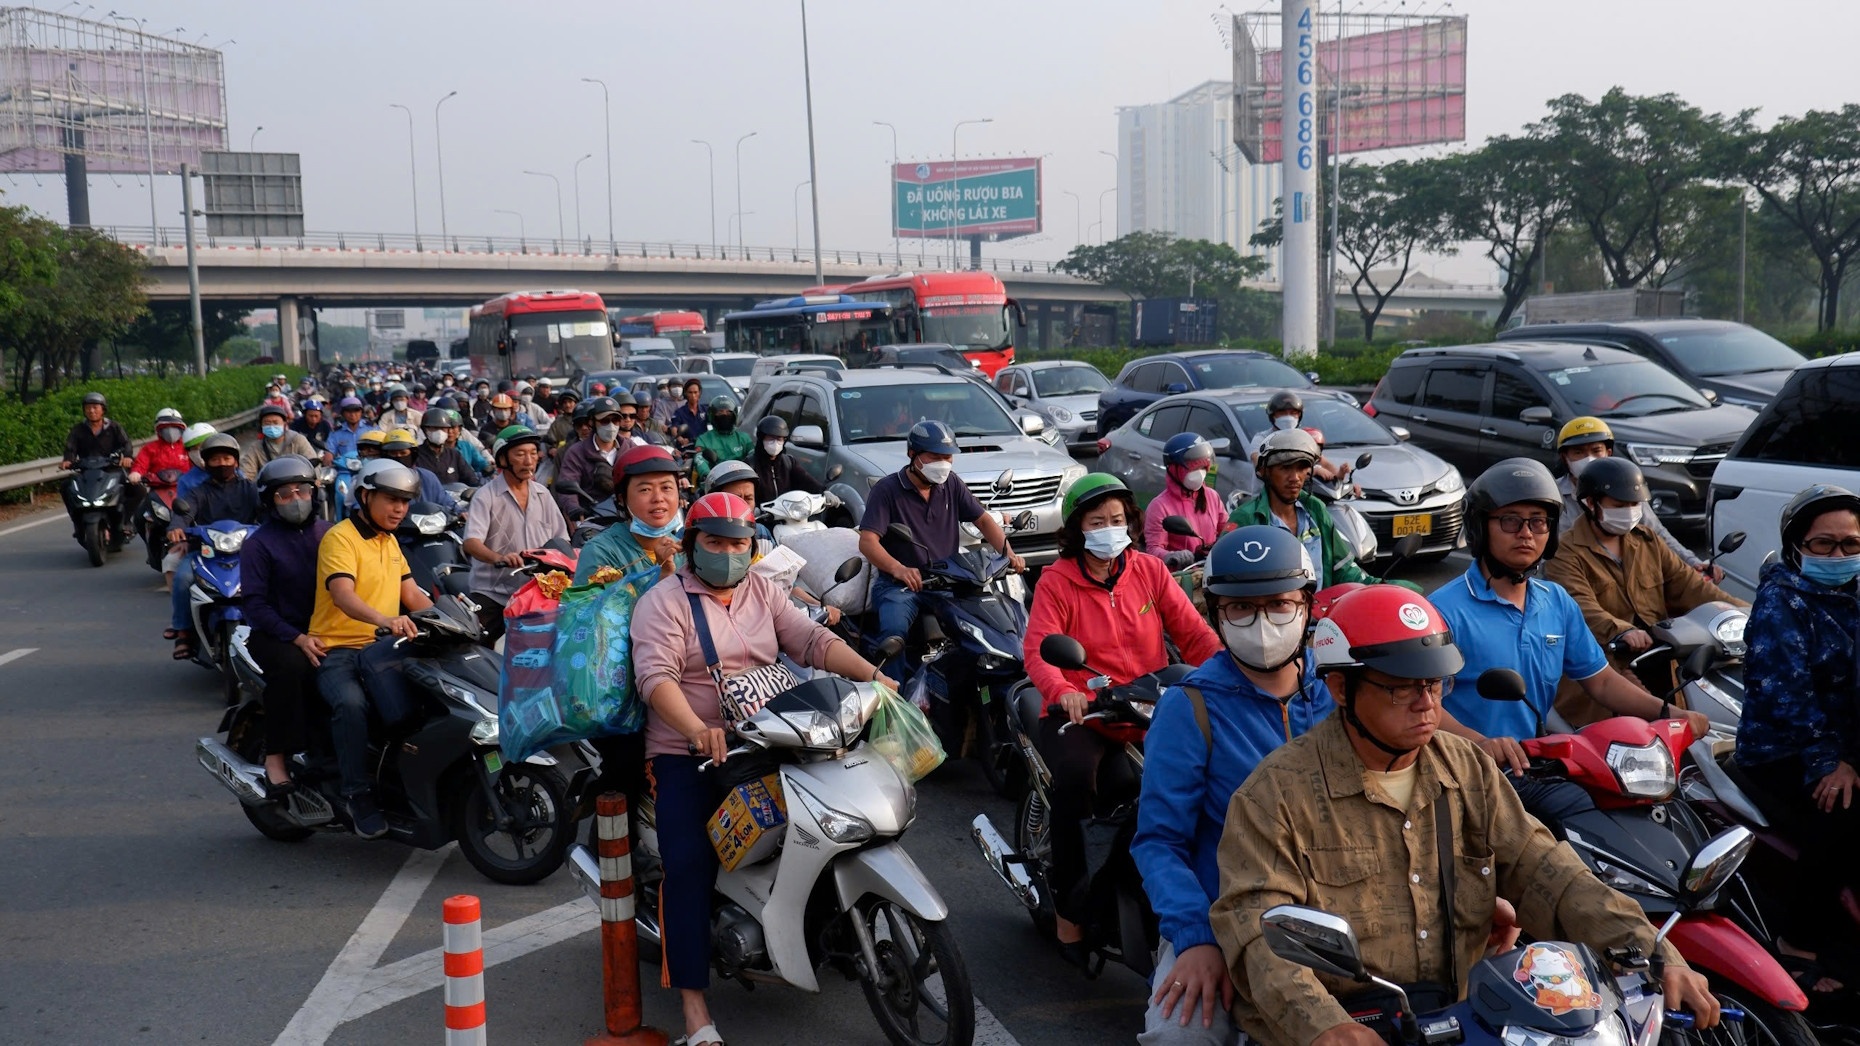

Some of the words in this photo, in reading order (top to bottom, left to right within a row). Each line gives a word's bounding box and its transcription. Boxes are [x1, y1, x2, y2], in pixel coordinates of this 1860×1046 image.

[906, 187, 923, 203] ĐÃ
[926, 184, 961, 203] UỐNG
[964, 185, 998, 203] RƯỢU
[1002, 186, 1023, 199] BIA
[923, 204, 966, 222] KHÔNG
[968, 203, 989, 219] LÁI
[992, 206, 1007, 218] XE
[749, 796, 761, 809] 4
[733, 834, 743, 849] 4
[739, 822, 754, 841] LON
[792, 838, 821, 851] HONDA
